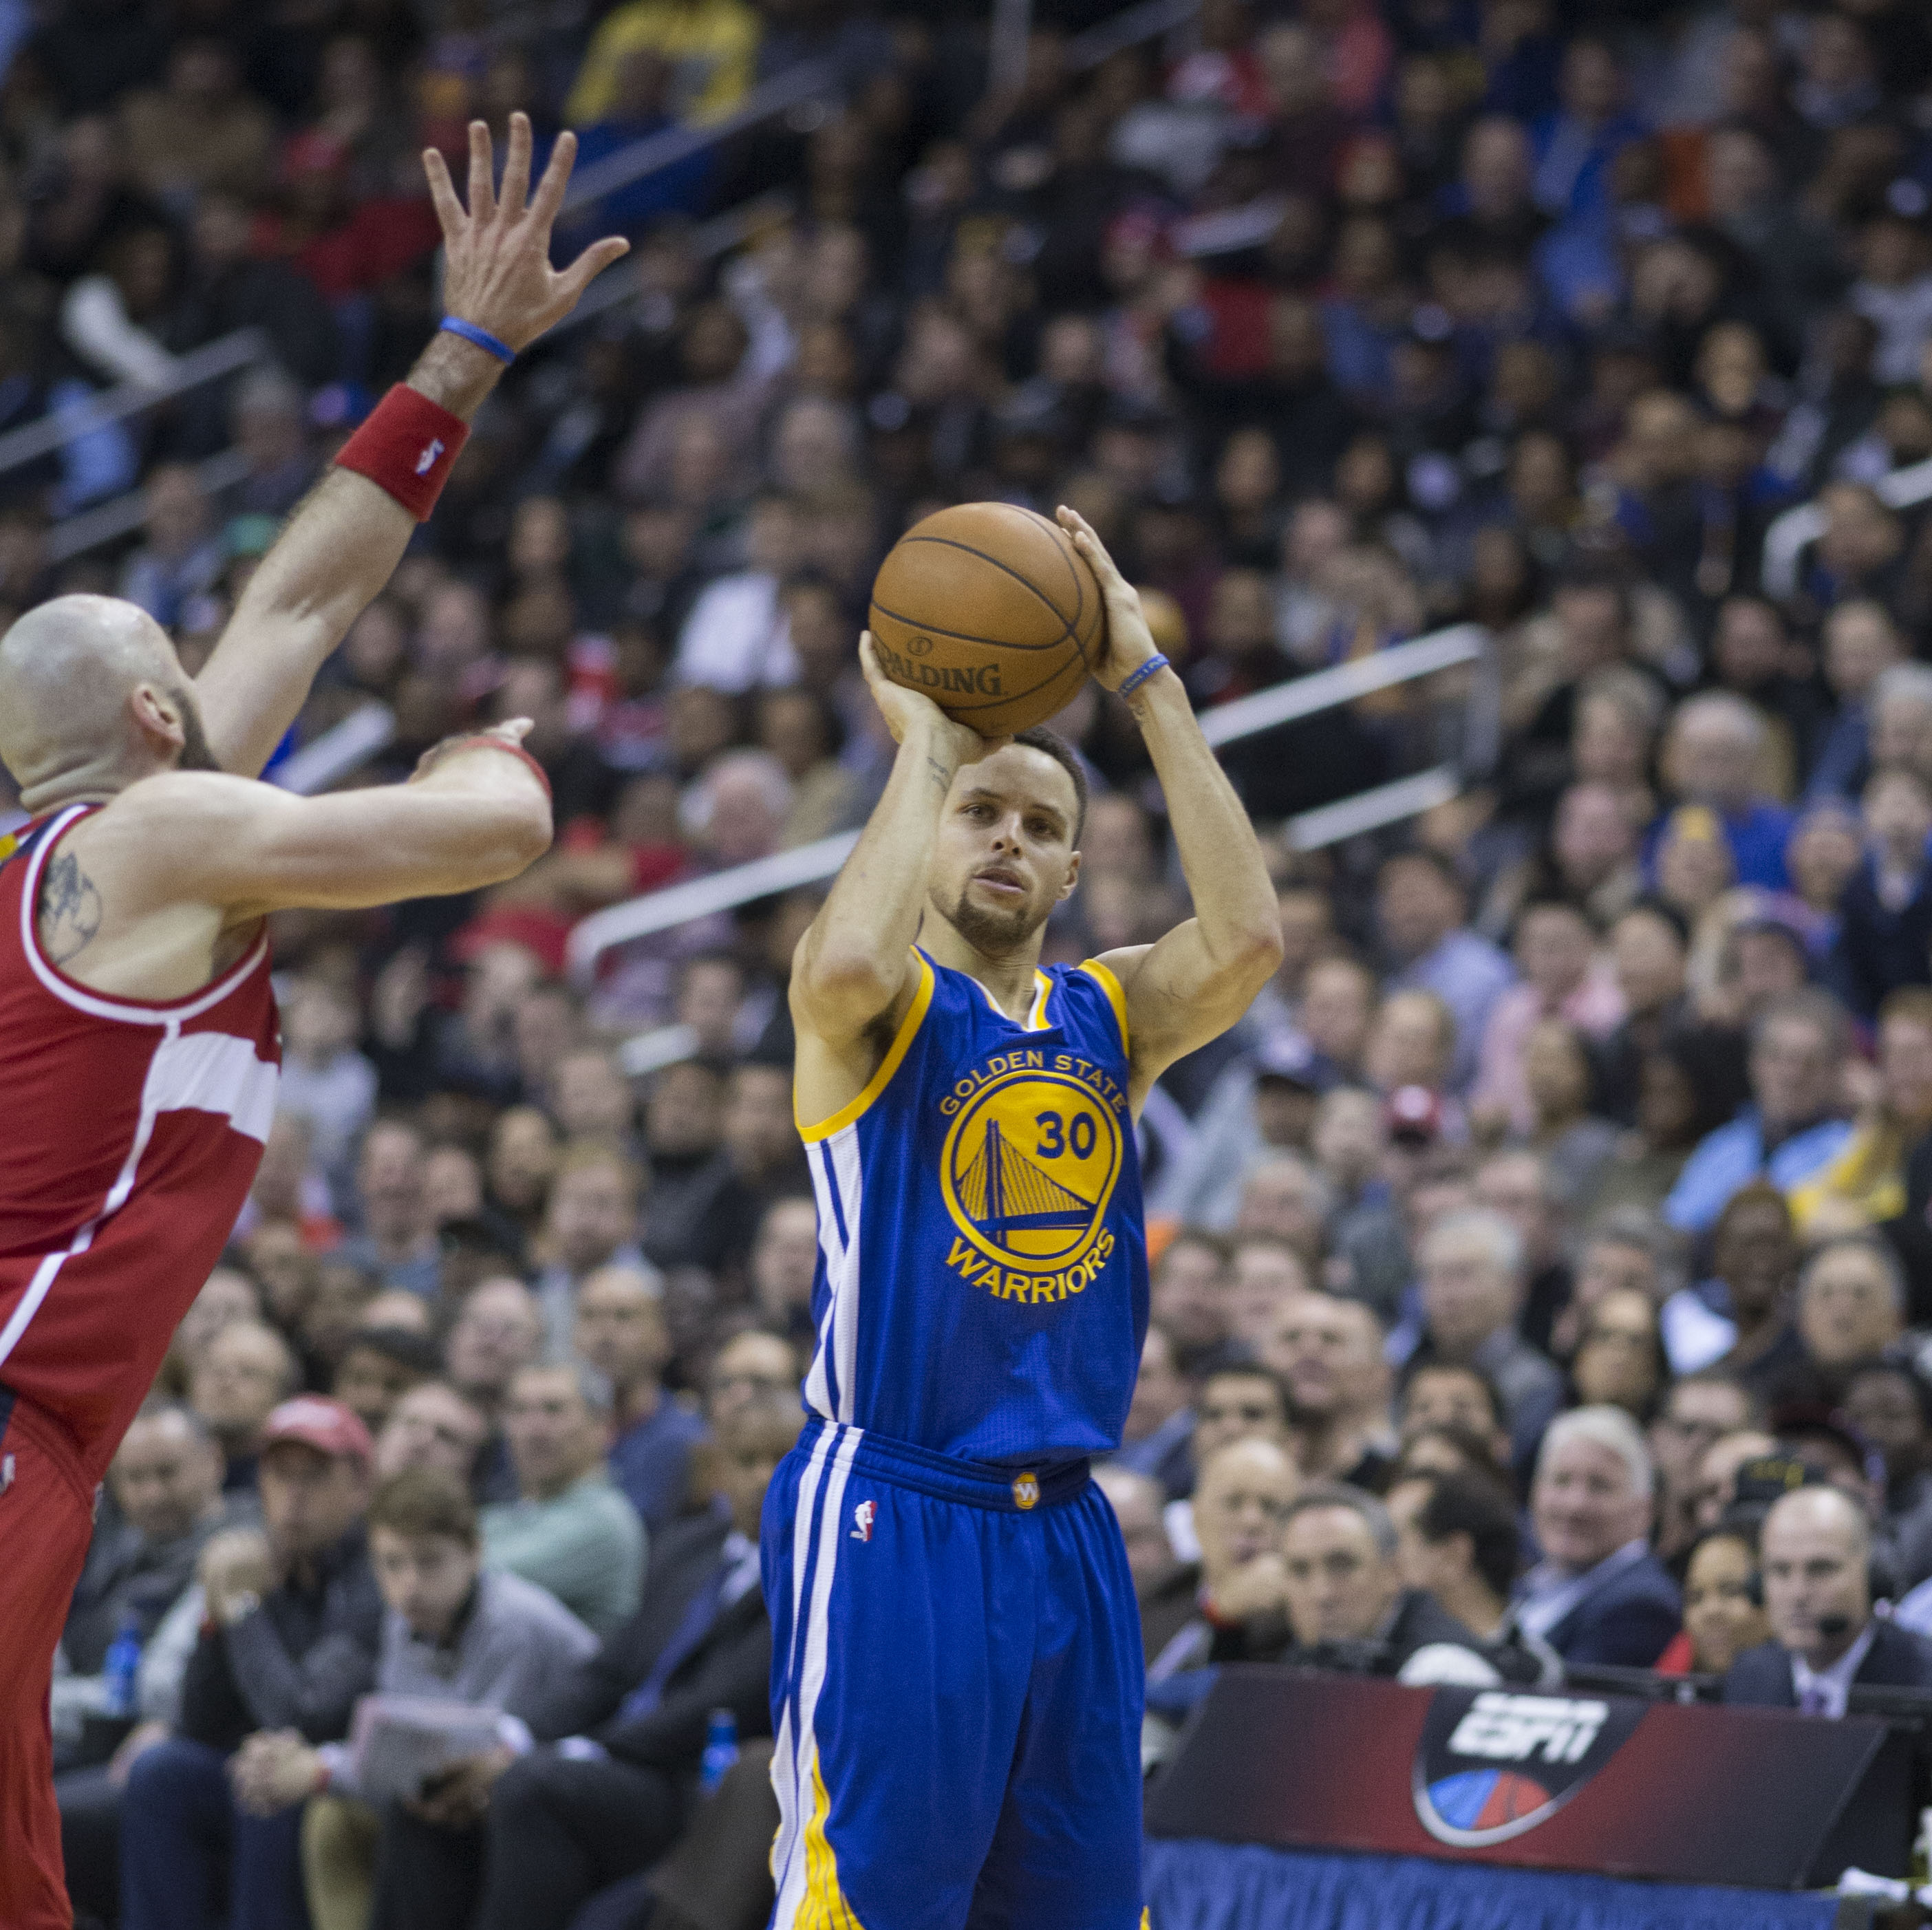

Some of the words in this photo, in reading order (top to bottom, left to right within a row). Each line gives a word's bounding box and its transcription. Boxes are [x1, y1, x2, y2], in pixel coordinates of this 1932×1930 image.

[939, 1049, 1044, 1115] GOLDEN
[1055, 1054, 1128, 1113] STATE
[1035, 1110, 1097, 1161] 30
[945, 1227, 1115, 1305] WARRIORS
[1014, 1482, 1038, 1501] W
[1448, 1691, 1609, 1763] ESPN
